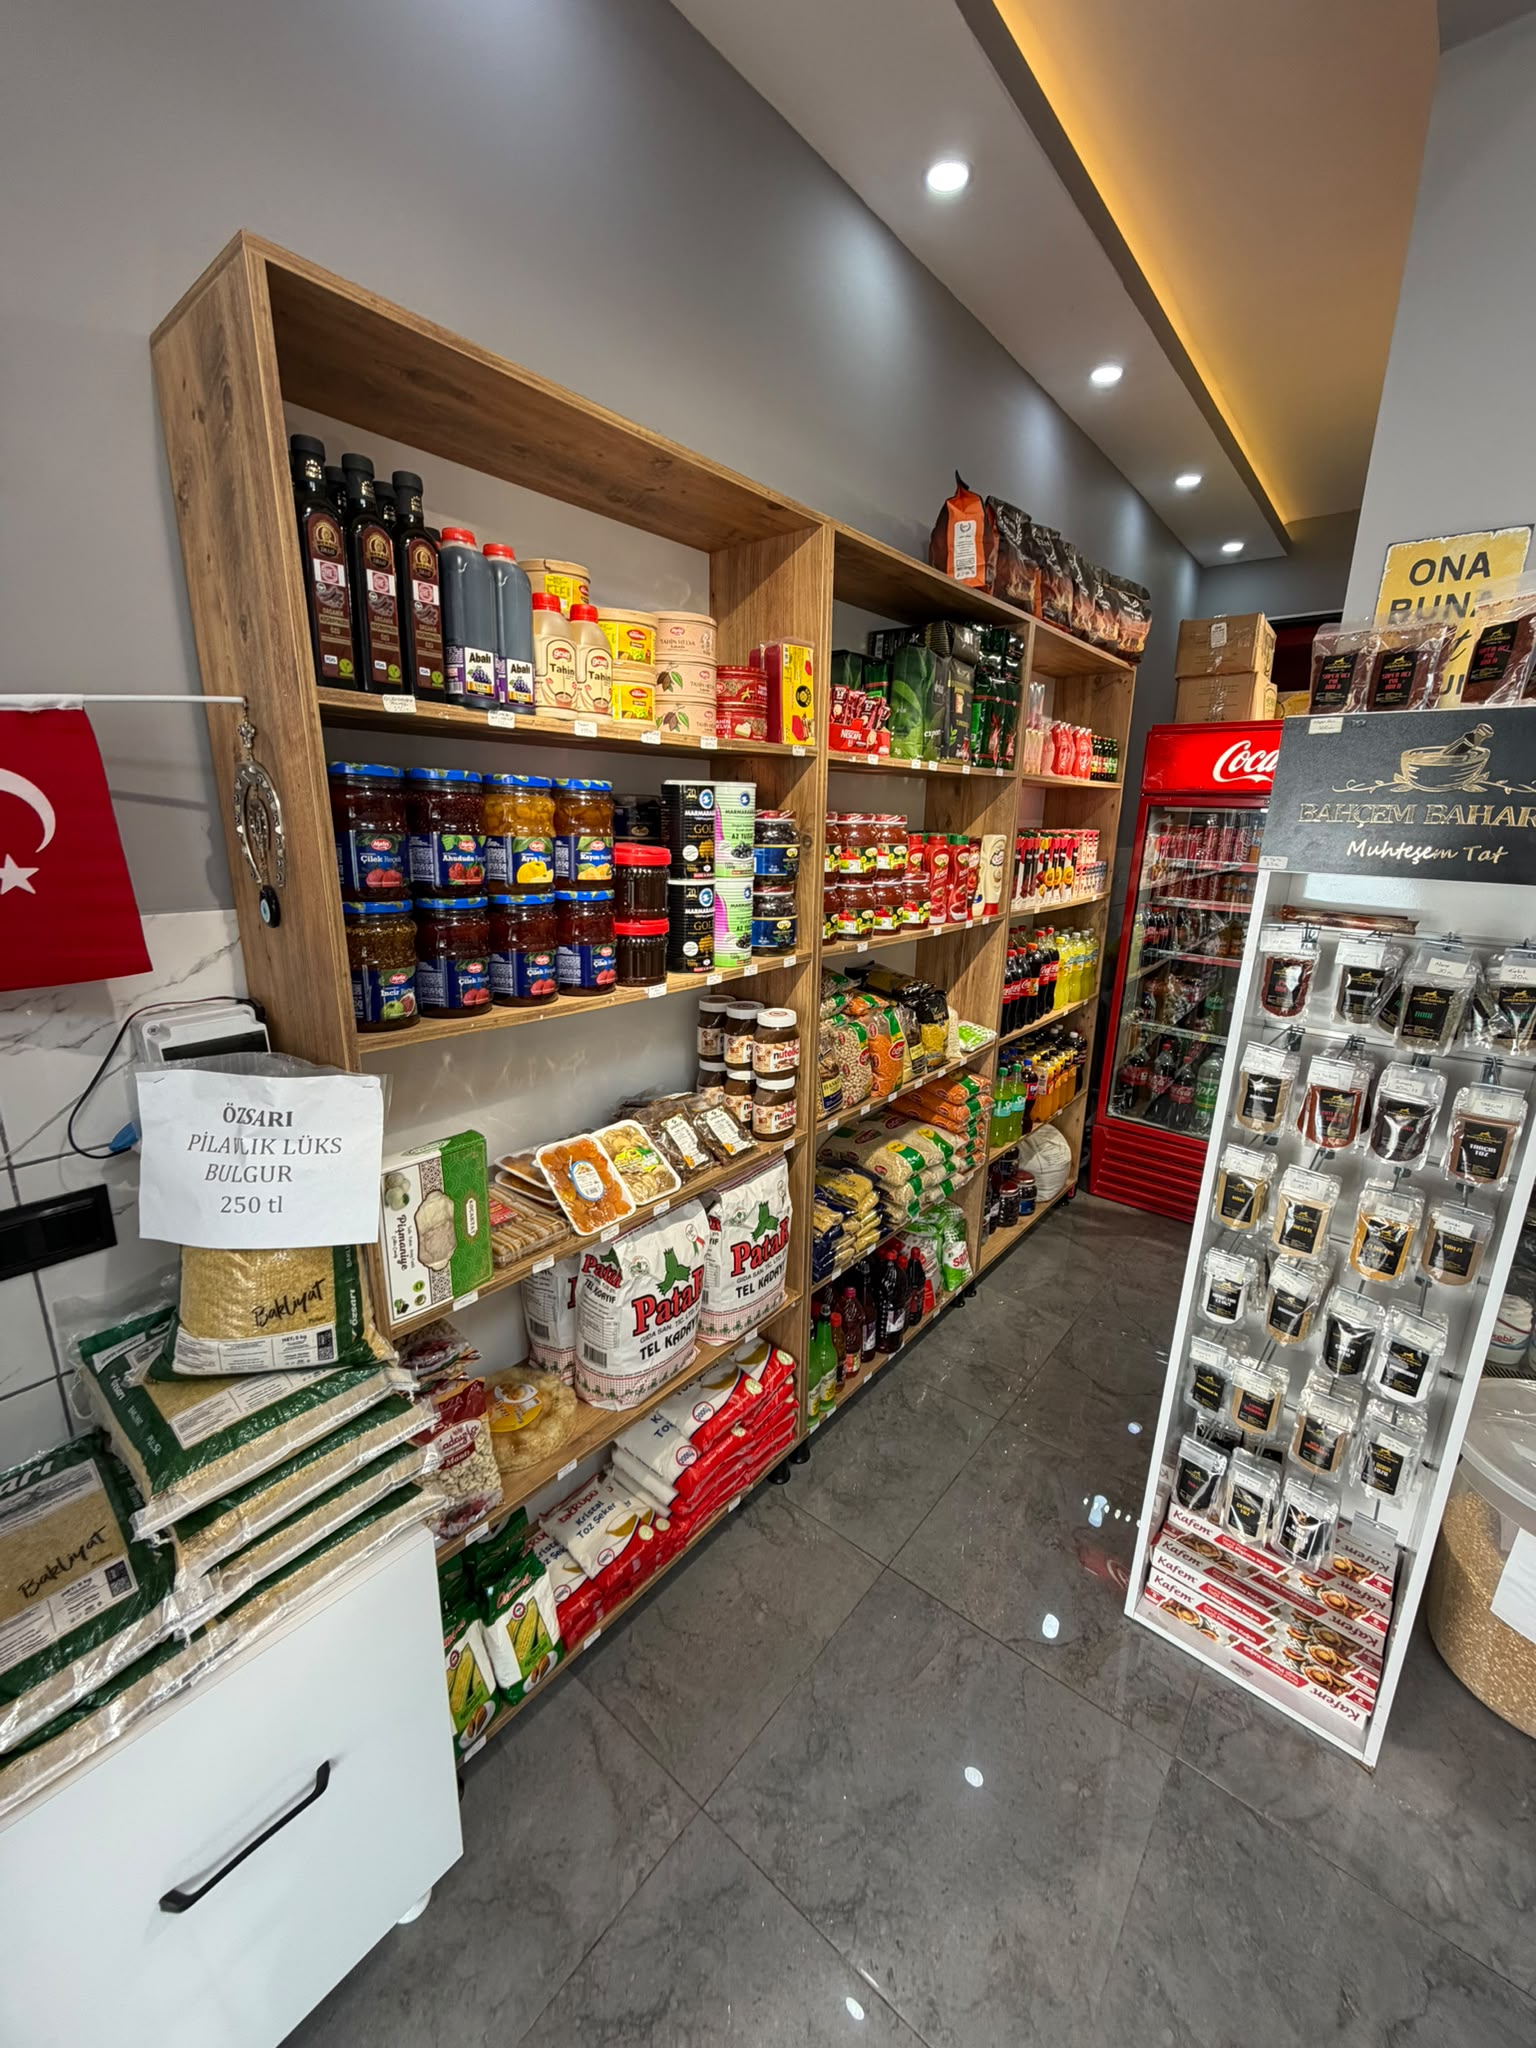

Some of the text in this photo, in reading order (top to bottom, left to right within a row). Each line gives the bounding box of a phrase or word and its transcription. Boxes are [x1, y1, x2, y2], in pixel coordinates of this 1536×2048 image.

[1408, 551, 1491, 588] ONA
[469, 652, 492, 665] Abalı
[510, 662, 532, 675] Abalı
[549, 662, 575, 676] Tahin
[587, 670, 611, 684] Tahin
[694, 823, 714, 834] GOL
[1297, 803, 1417, 829] BAHÇEM
[361, 855, 383, 864] Çilek
[1346, 838, 1509, 865] Muhteşem Tat
[1195, 1082, 1217, 1097] Spri
[222, 1103, 293, 1128] ÖZSARI
[283, 1135, 342, 1156] LÜKS
[204, 1163, 293, 1184] BULGUR
[220, 1195, 282, 1214] 250 tl
[395, 1214, 410, 1272] Pişmaniye
[251, 1279, 326, 1328] Bakliyat
[736, 1283, 755, 1300] TEL
[639, 1341, 661, 1361] TEL
[575, 1500, 604, 1527] Kristal
[1172, 1509, 1213, 1538] Kafem
[575, 1522, 595, 1540] Toz
[18, 1525, 107, 1600] Bakliyat
[1162, 1540, 1204, 1567] Kafem
[1341, 1543, 1391, 1573] Kafem
[1156, 1555, 1198, 1585] Kafem
[1153, 1573, 1195, 1605] Kafem
[1336, 1579, 1387, 1610] Kafem
[1328, 1615, 1379, 1648] Kafem
[1309, 1687, 1361, 1723] Kafem
